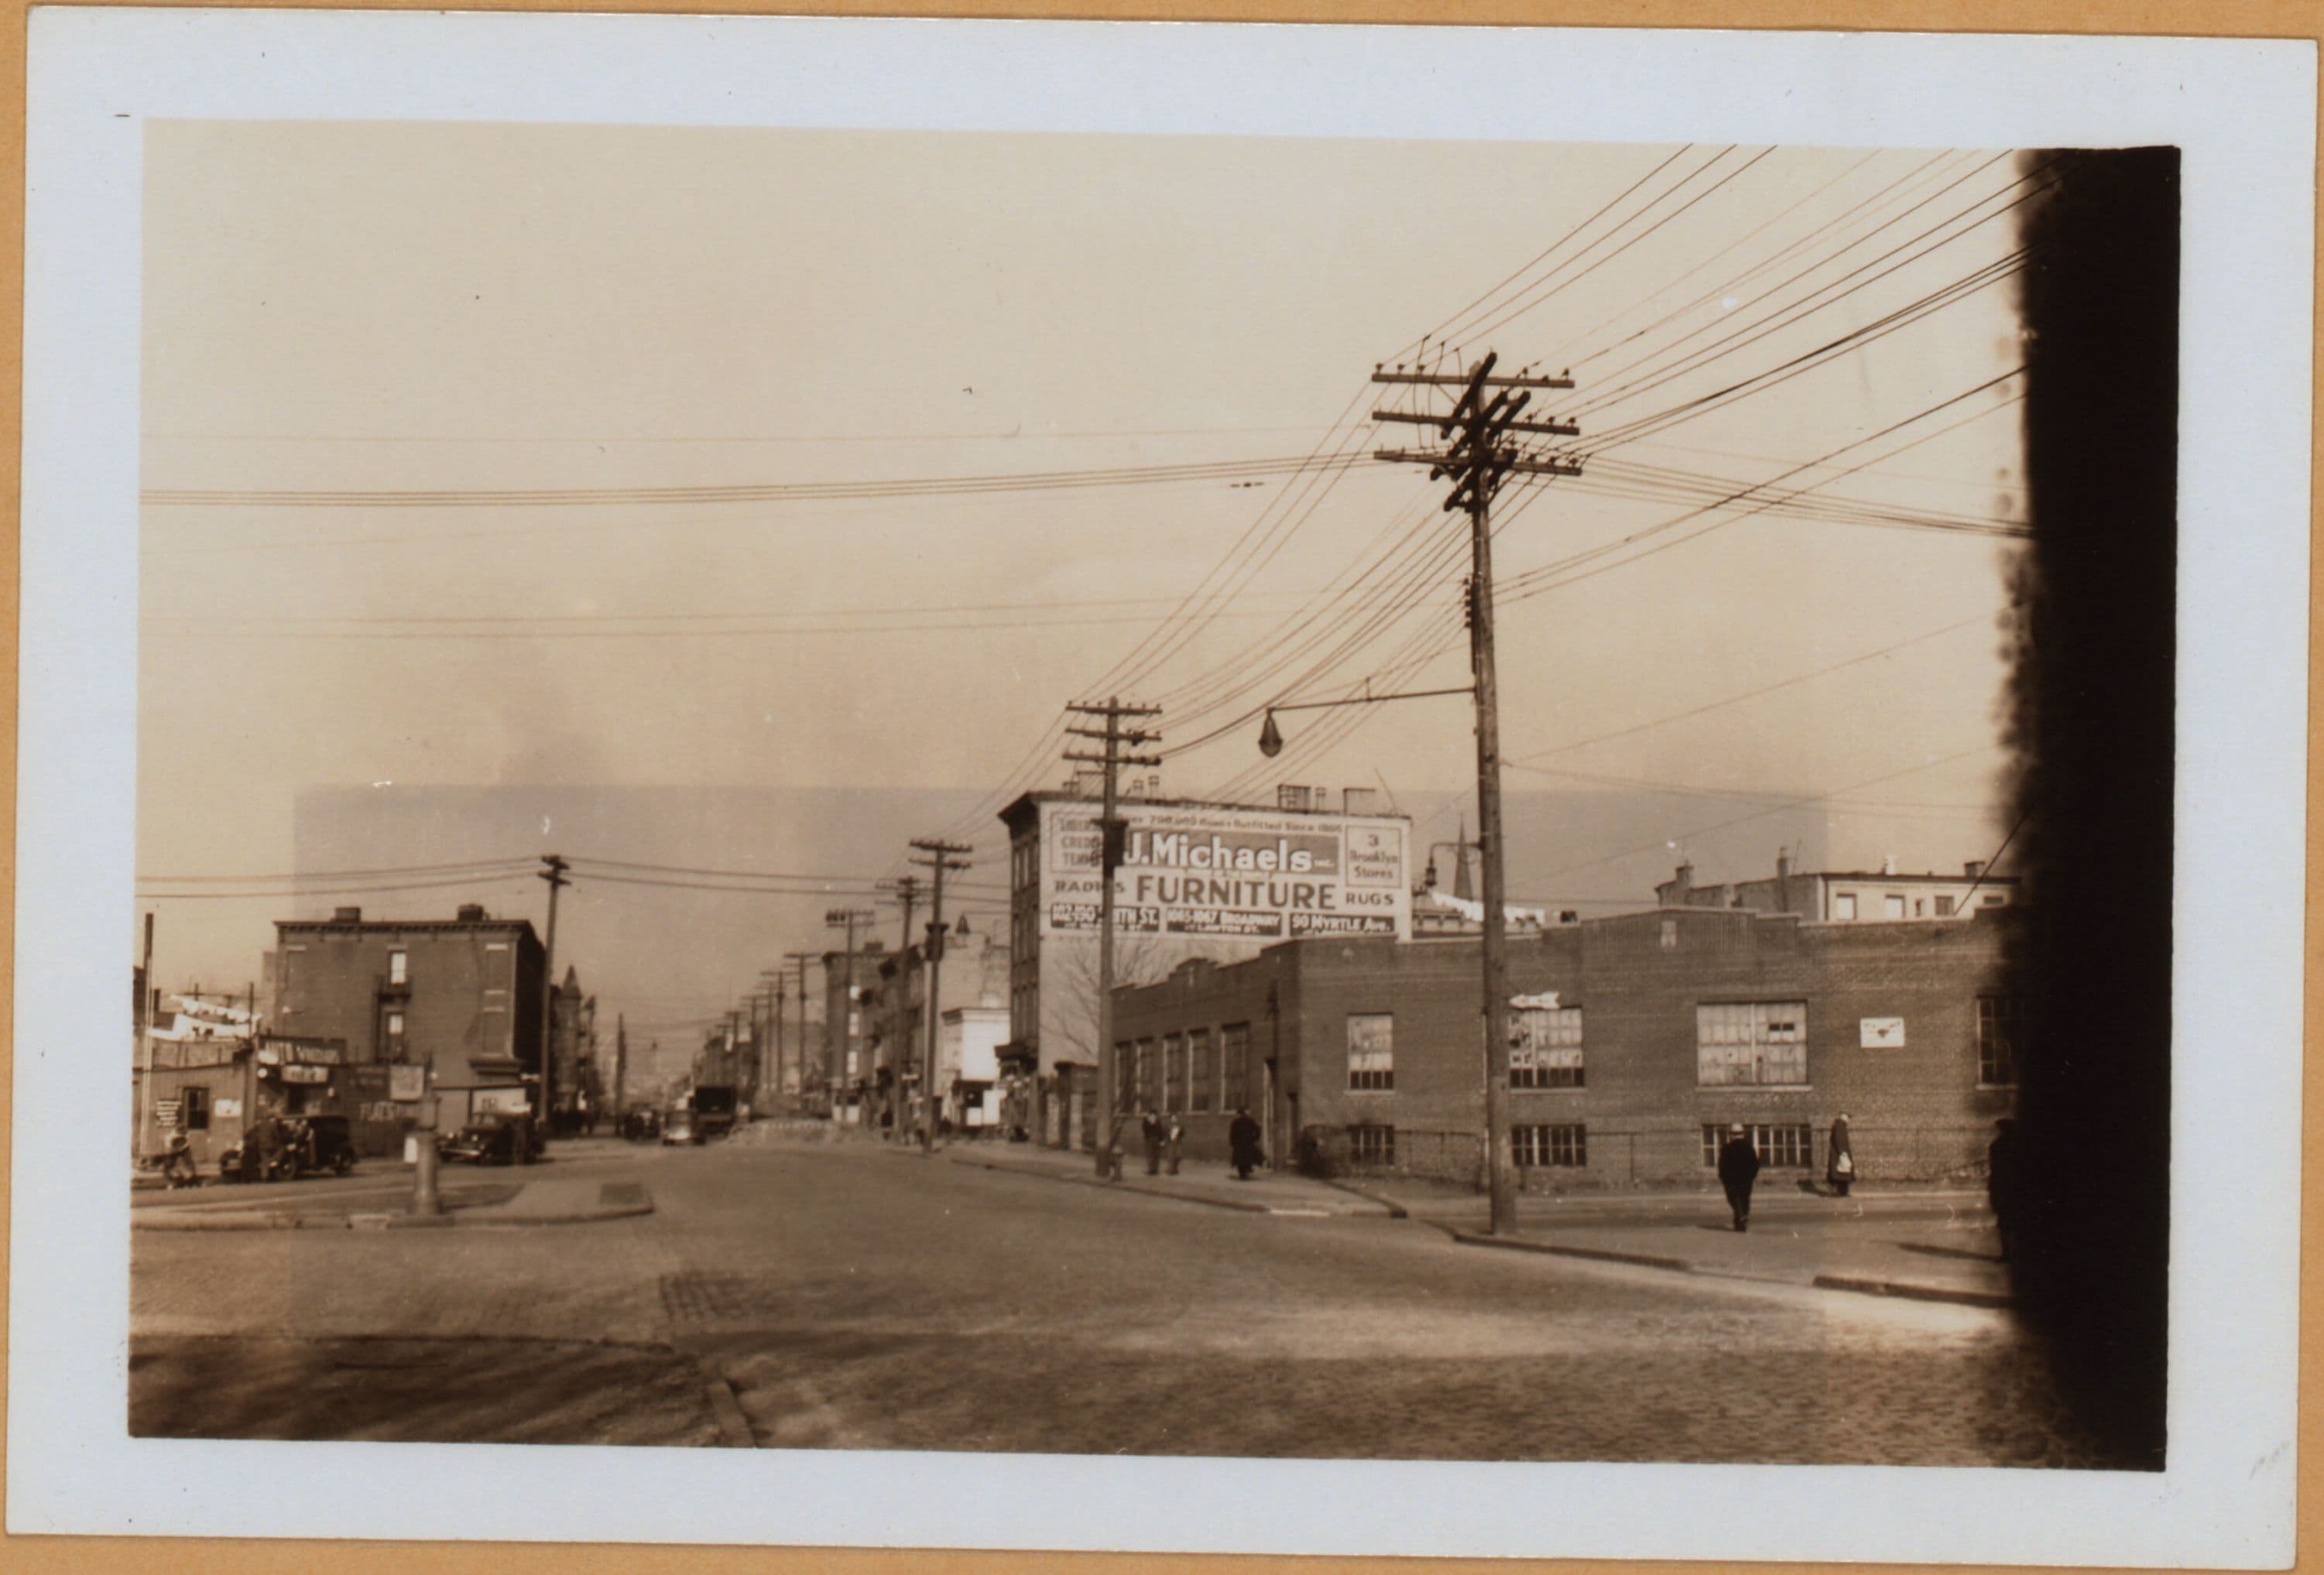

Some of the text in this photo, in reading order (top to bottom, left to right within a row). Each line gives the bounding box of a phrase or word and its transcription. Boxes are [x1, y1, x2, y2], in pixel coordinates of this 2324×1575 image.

[1368, 834, 1380, 847] 3
[1349, 849, 1399, 865] Brooklyn
[1354, 865, 1393, 879] Stores
[1055, 875, 1394, 910] RADIS FURNITURE RUGS
[1220, 910, 1281, 928] BROADWAY
[1310, 915, 1361, 933] MYRTLE
